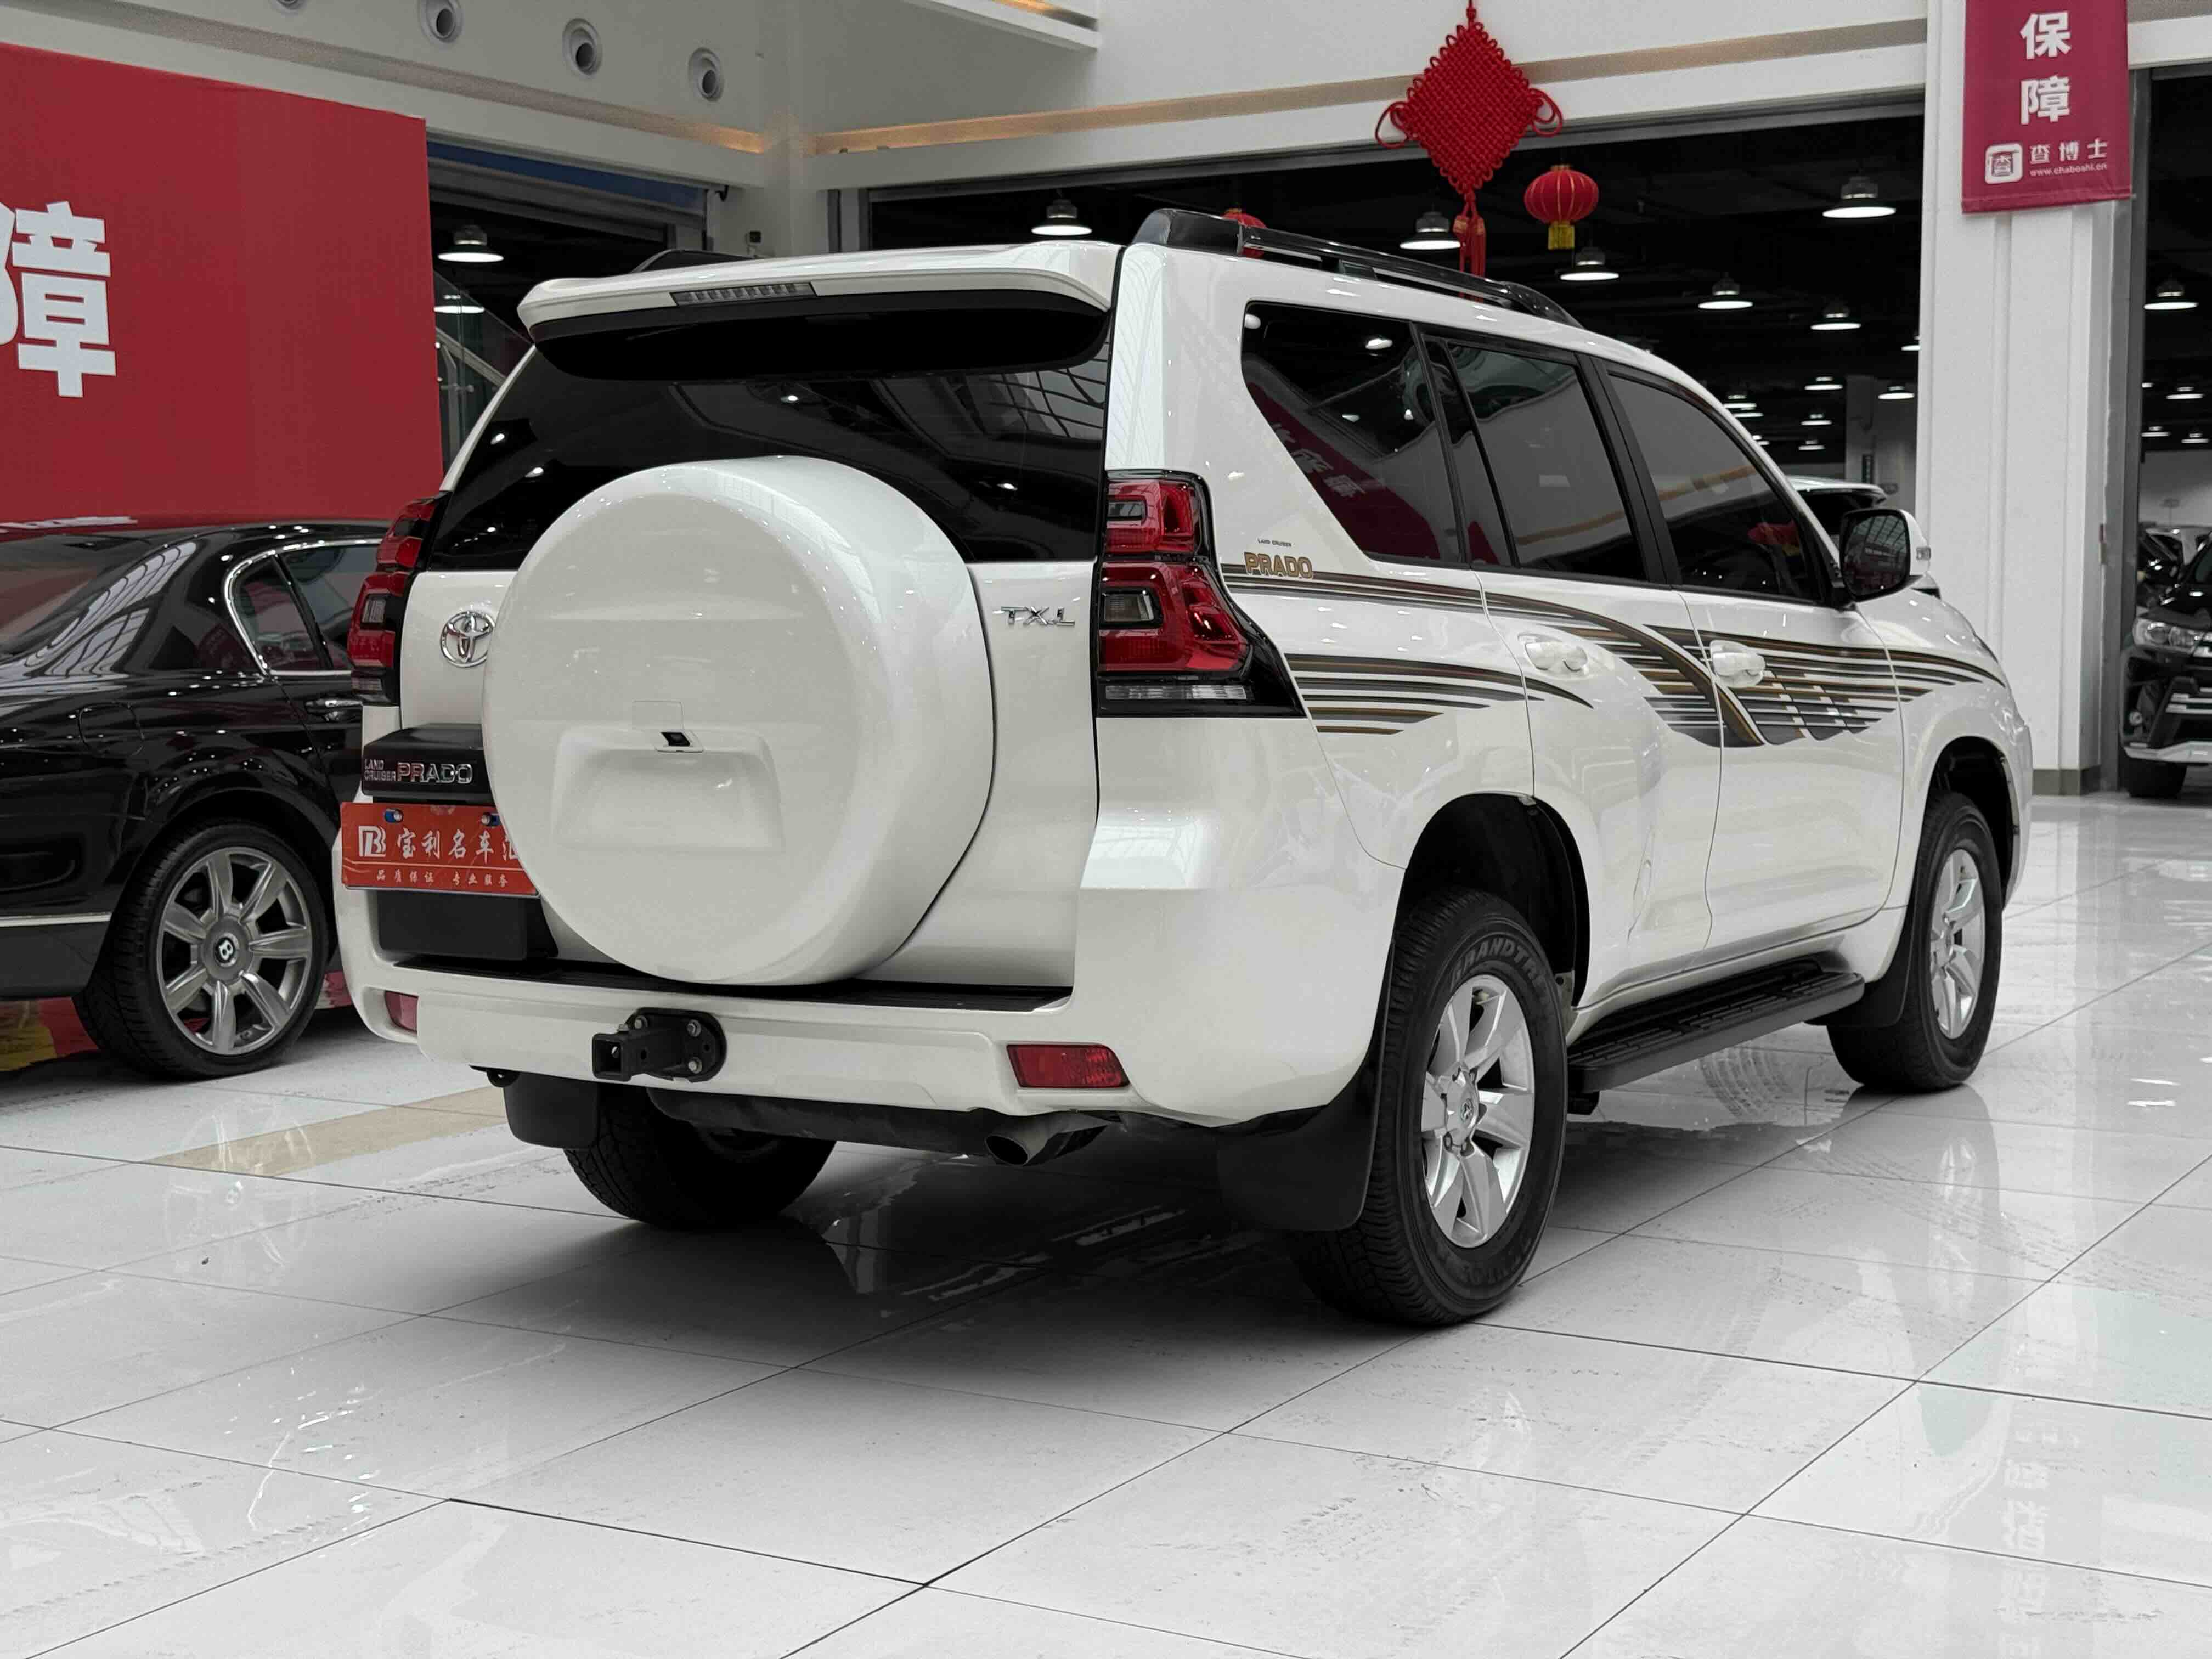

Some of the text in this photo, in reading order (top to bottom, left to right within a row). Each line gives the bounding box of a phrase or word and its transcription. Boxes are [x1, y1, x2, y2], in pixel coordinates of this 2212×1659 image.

[2019, 10, 2072, 126] 保障
[2029, 138, 2107, 165] 查博士
[1243, 552, 1312, 579] PRADO
[364, 759, 473, 784] LAND PRADO
[364, 770, 396, 782] CRUISER
